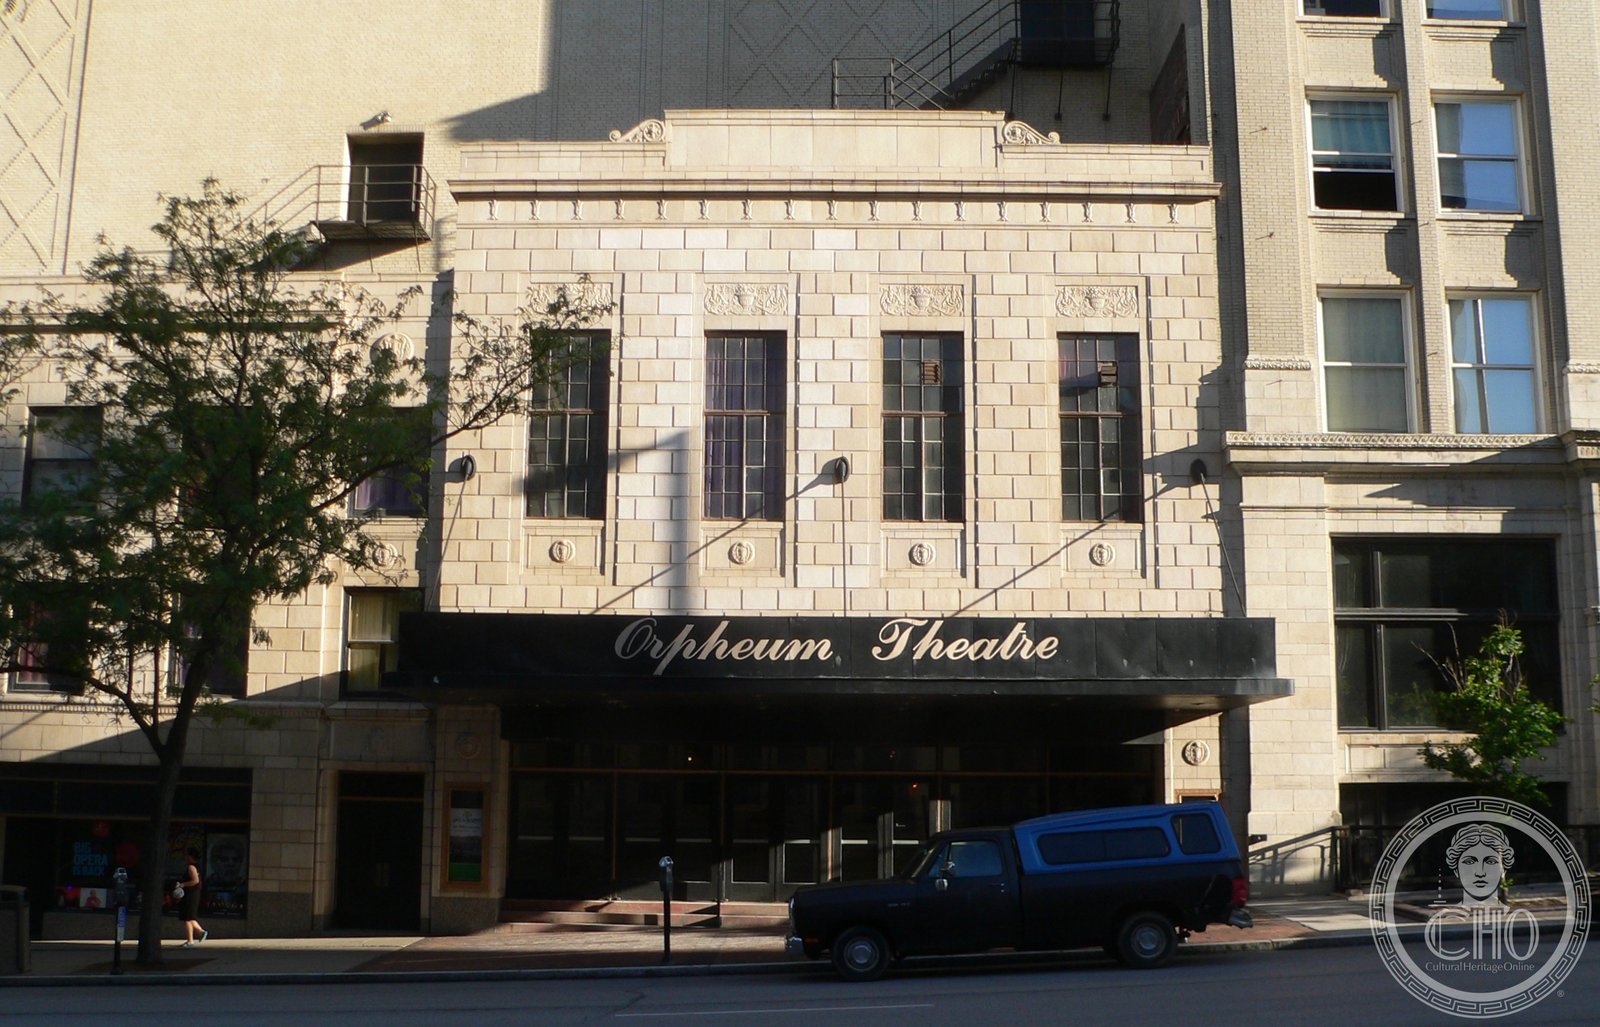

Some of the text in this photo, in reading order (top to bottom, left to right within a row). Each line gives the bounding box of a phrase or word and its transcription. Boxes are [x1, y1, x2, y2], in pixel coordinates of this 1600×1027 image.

[614, 617, 1059, 676] Orpheum Theatre
[73, 841, 92, 853] BIG
[73, 854, 109, 865] OPERA
